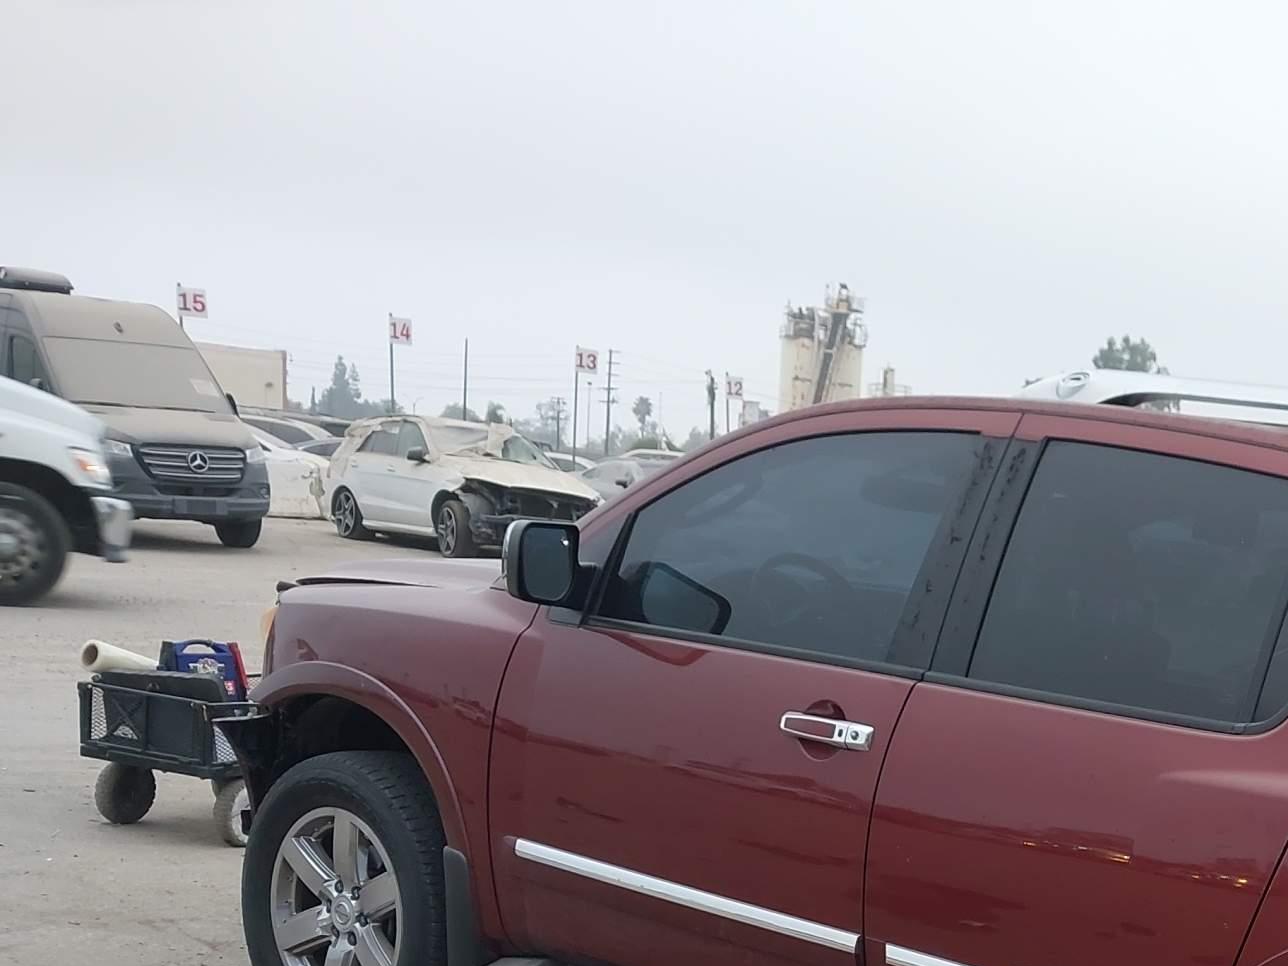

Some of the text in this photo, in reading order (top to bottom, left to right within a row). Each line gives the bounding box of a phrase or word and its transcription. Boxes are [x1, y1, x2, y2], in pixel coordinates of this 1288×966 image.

[178, 293, 206, 312] 15
[390, 322, 411, 340] 14
[576, 352, 597, 370] 13
[727, 381, 743, 397] 12
